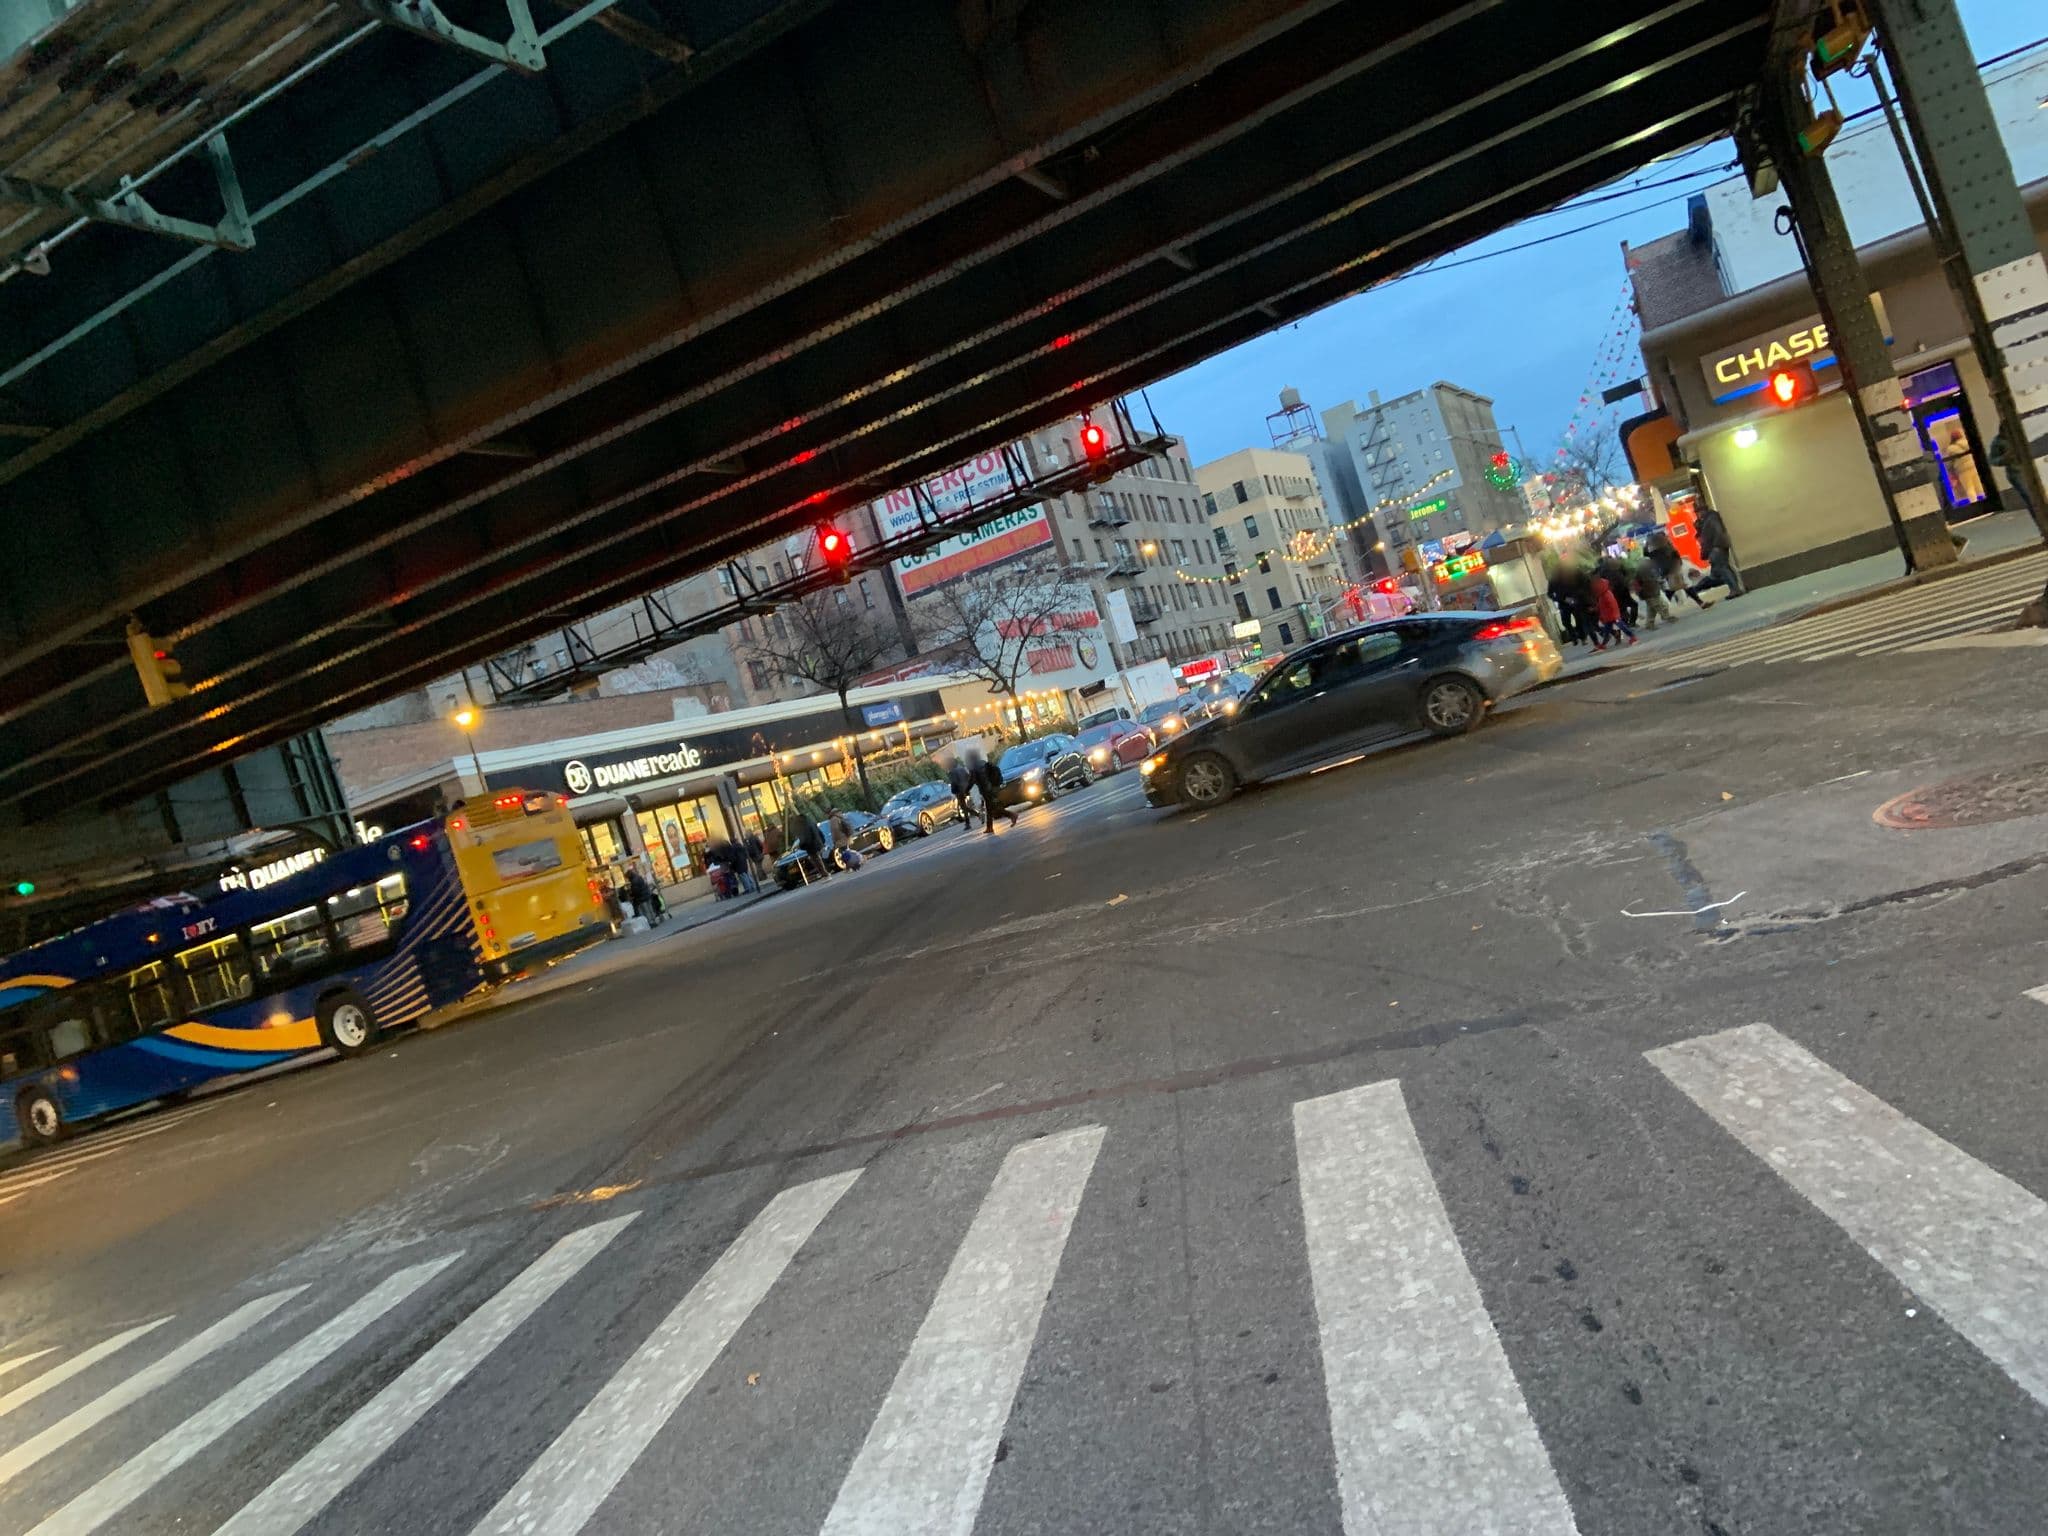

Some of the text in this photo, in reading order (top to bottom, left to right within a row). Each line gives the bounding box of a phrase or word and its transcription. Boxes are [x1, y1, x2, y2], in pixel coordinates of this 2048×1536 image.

[1715, 324, 1829, 383] CHASE
[889, 500, 943, 528] WHOLSAE
[1410, 504, 1438, 520] Jerome
